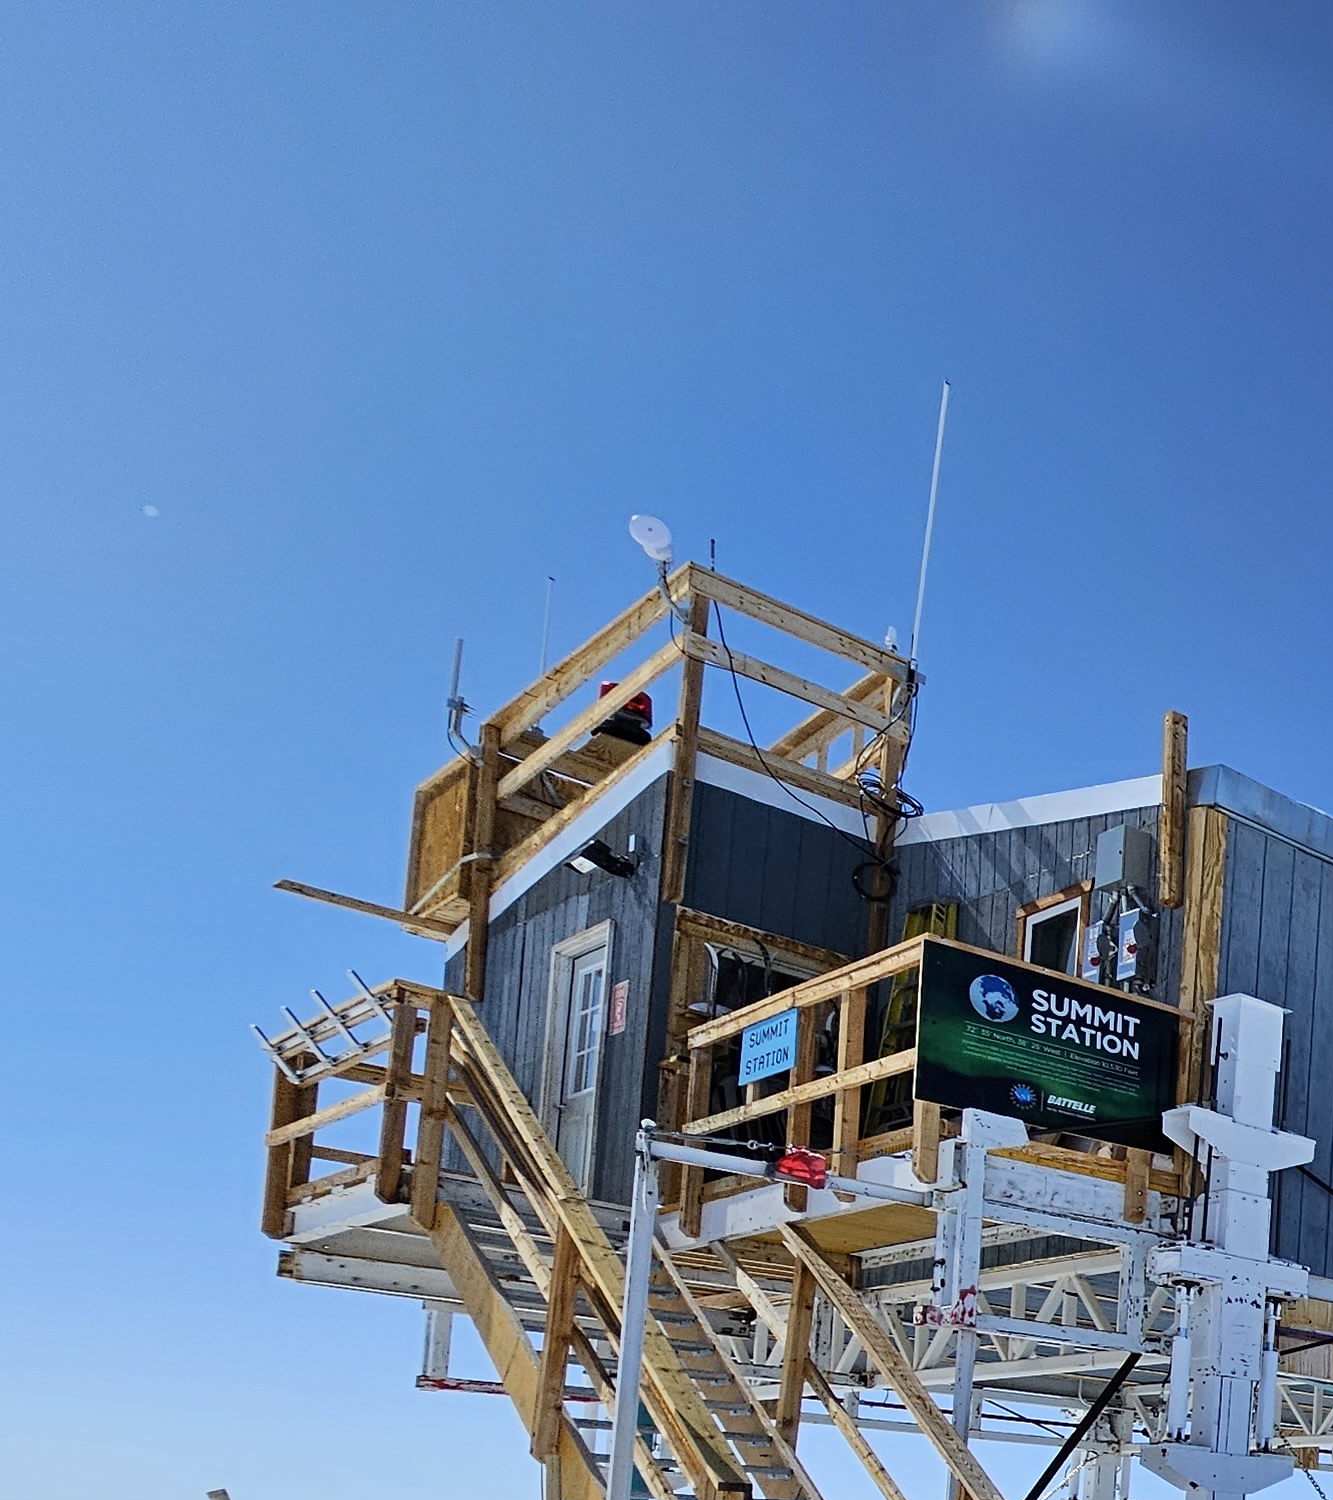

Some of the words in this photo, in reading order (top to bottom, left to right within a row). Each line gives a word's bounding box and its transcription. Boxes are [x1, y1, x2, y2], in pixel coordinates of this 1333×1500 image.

[1031, 989, 1141, 1038] SUMMIT
[749, 1018, 789, 1048] SUMMIT
[1030, 1013, 1140, 1061] STATION
[745, 1046, 789, 1075] STATION
[1069, 1052, 1101, 1066] Elevation
[1123, 1067, 1139, 1077] Feet
[1047, 1094, 1096, 1114] BATTELLE
